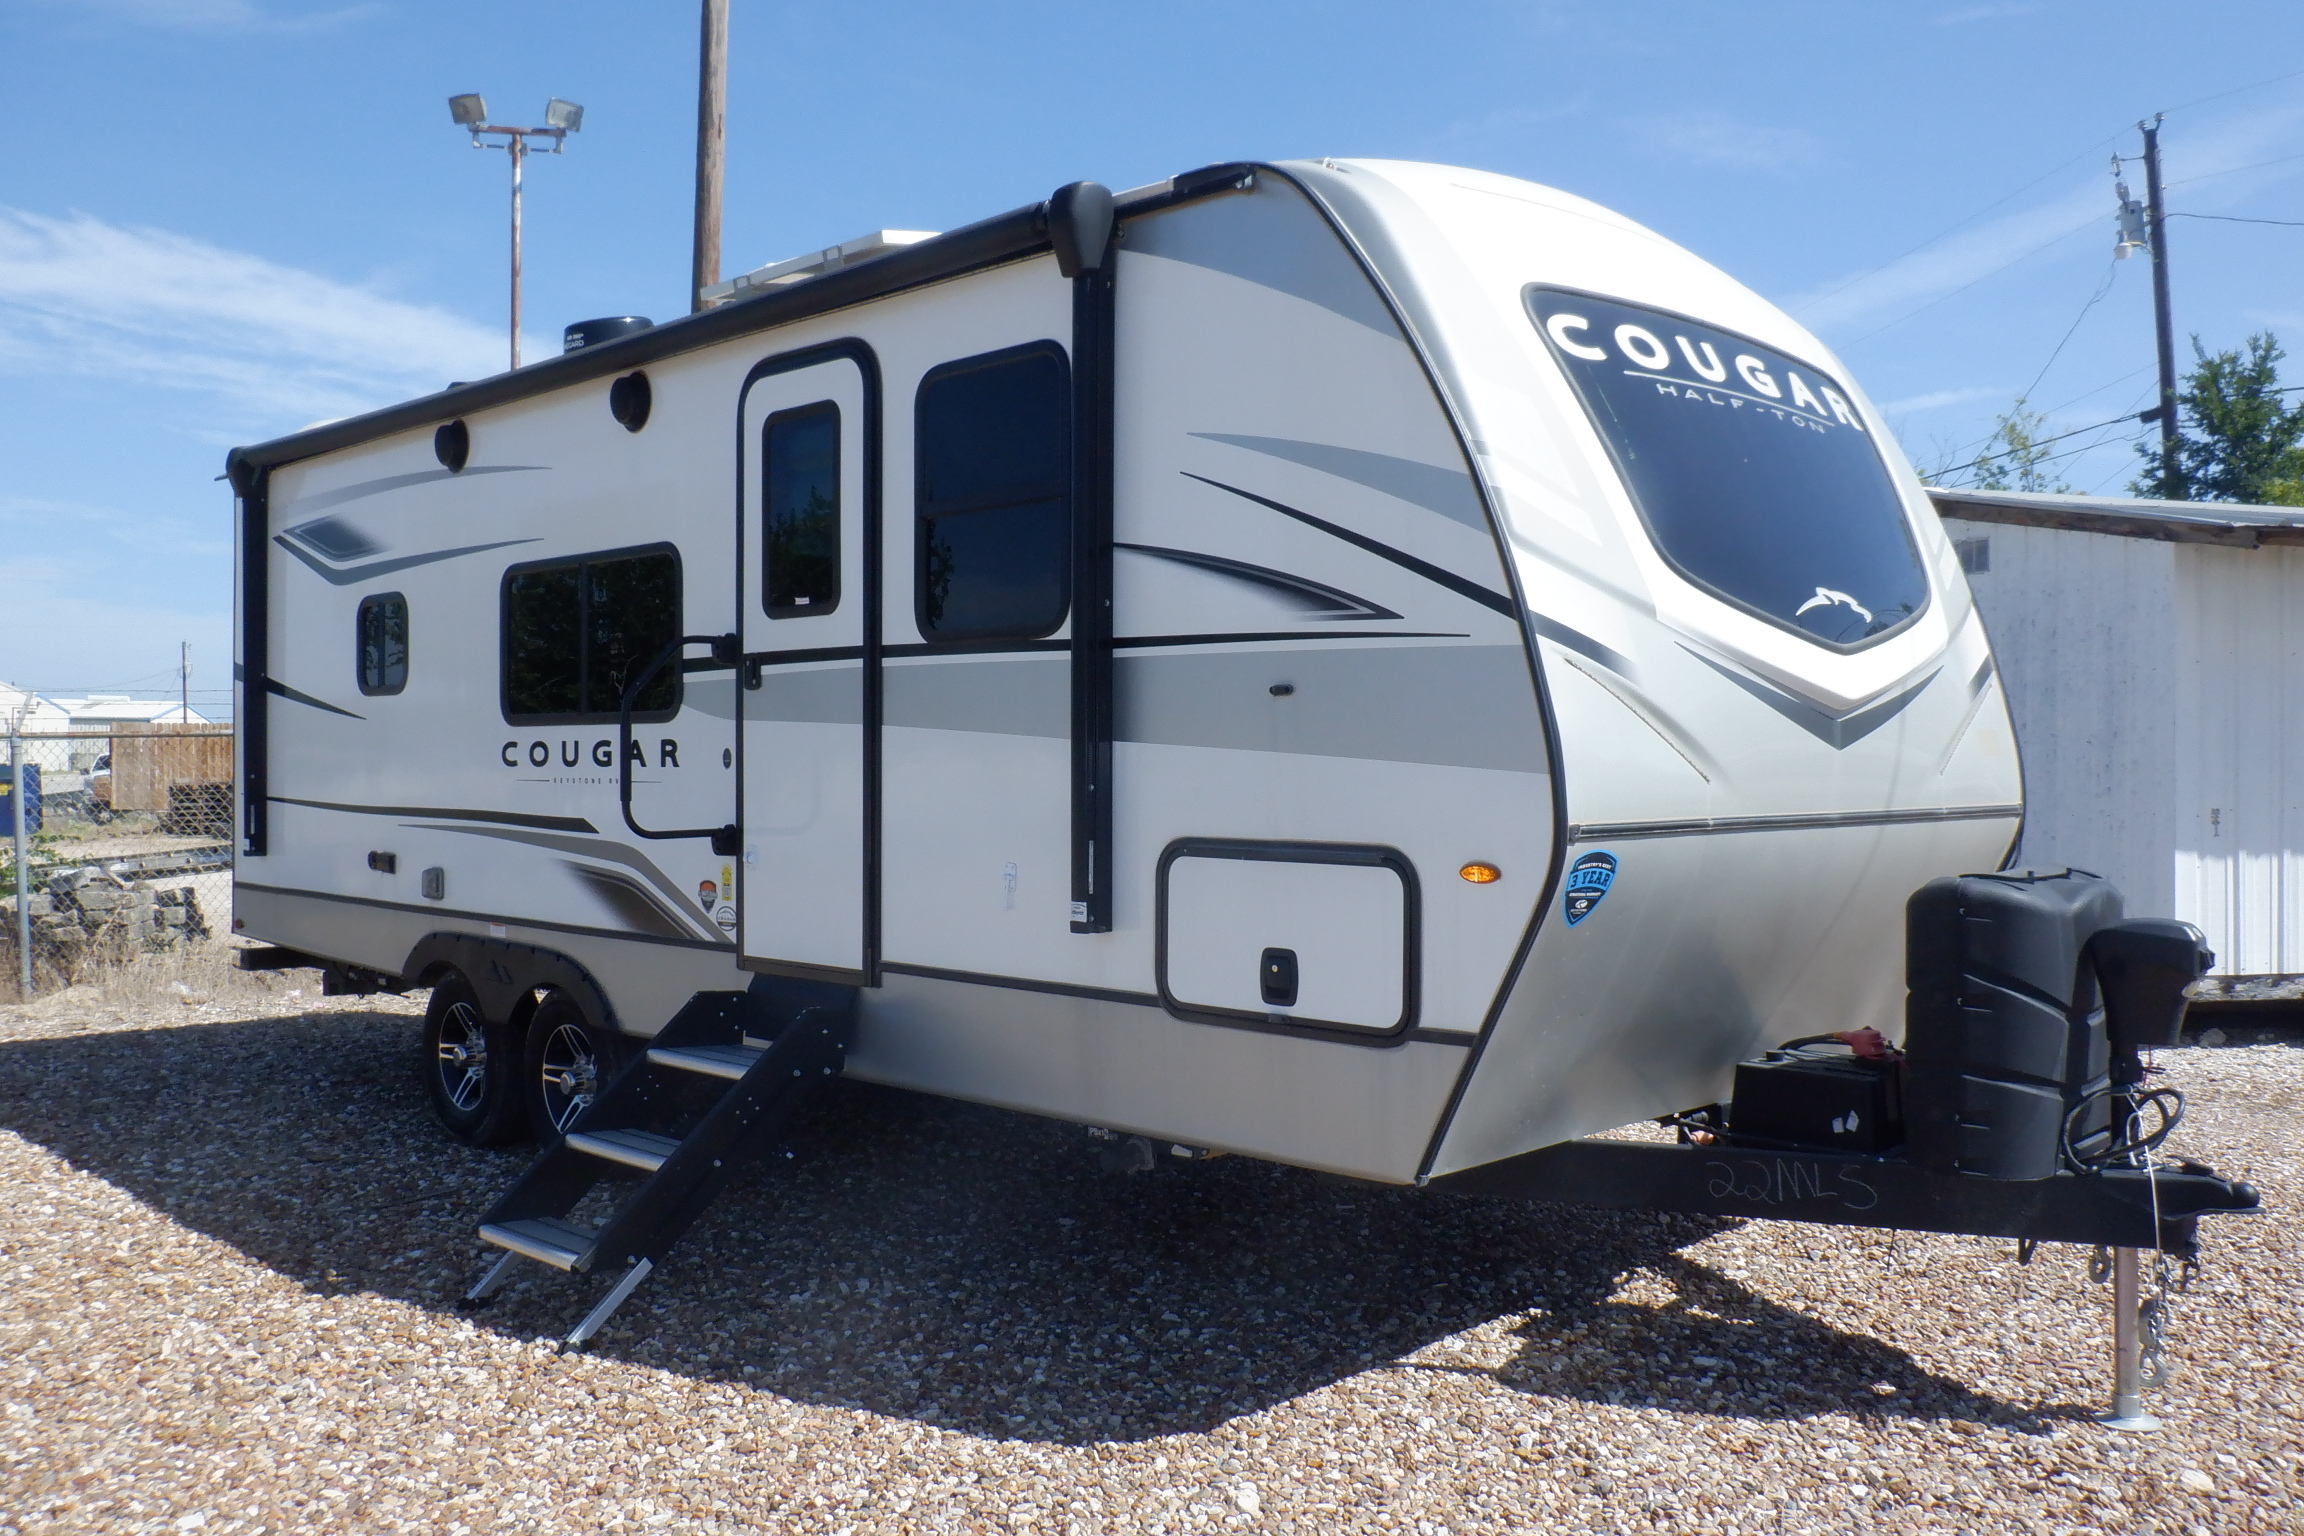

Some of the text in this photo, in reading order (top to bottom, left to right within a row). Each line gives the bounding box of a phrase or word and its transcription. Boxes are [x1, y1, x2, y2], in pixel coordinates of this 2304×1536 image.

[1546, 314, 1864, 432] COUGAR
[501, 738, 680, 768] COUGAR
[553, 777, 601, 785] KEYSTONE
[1570, 870, 1611, 888] 3 YEAR
